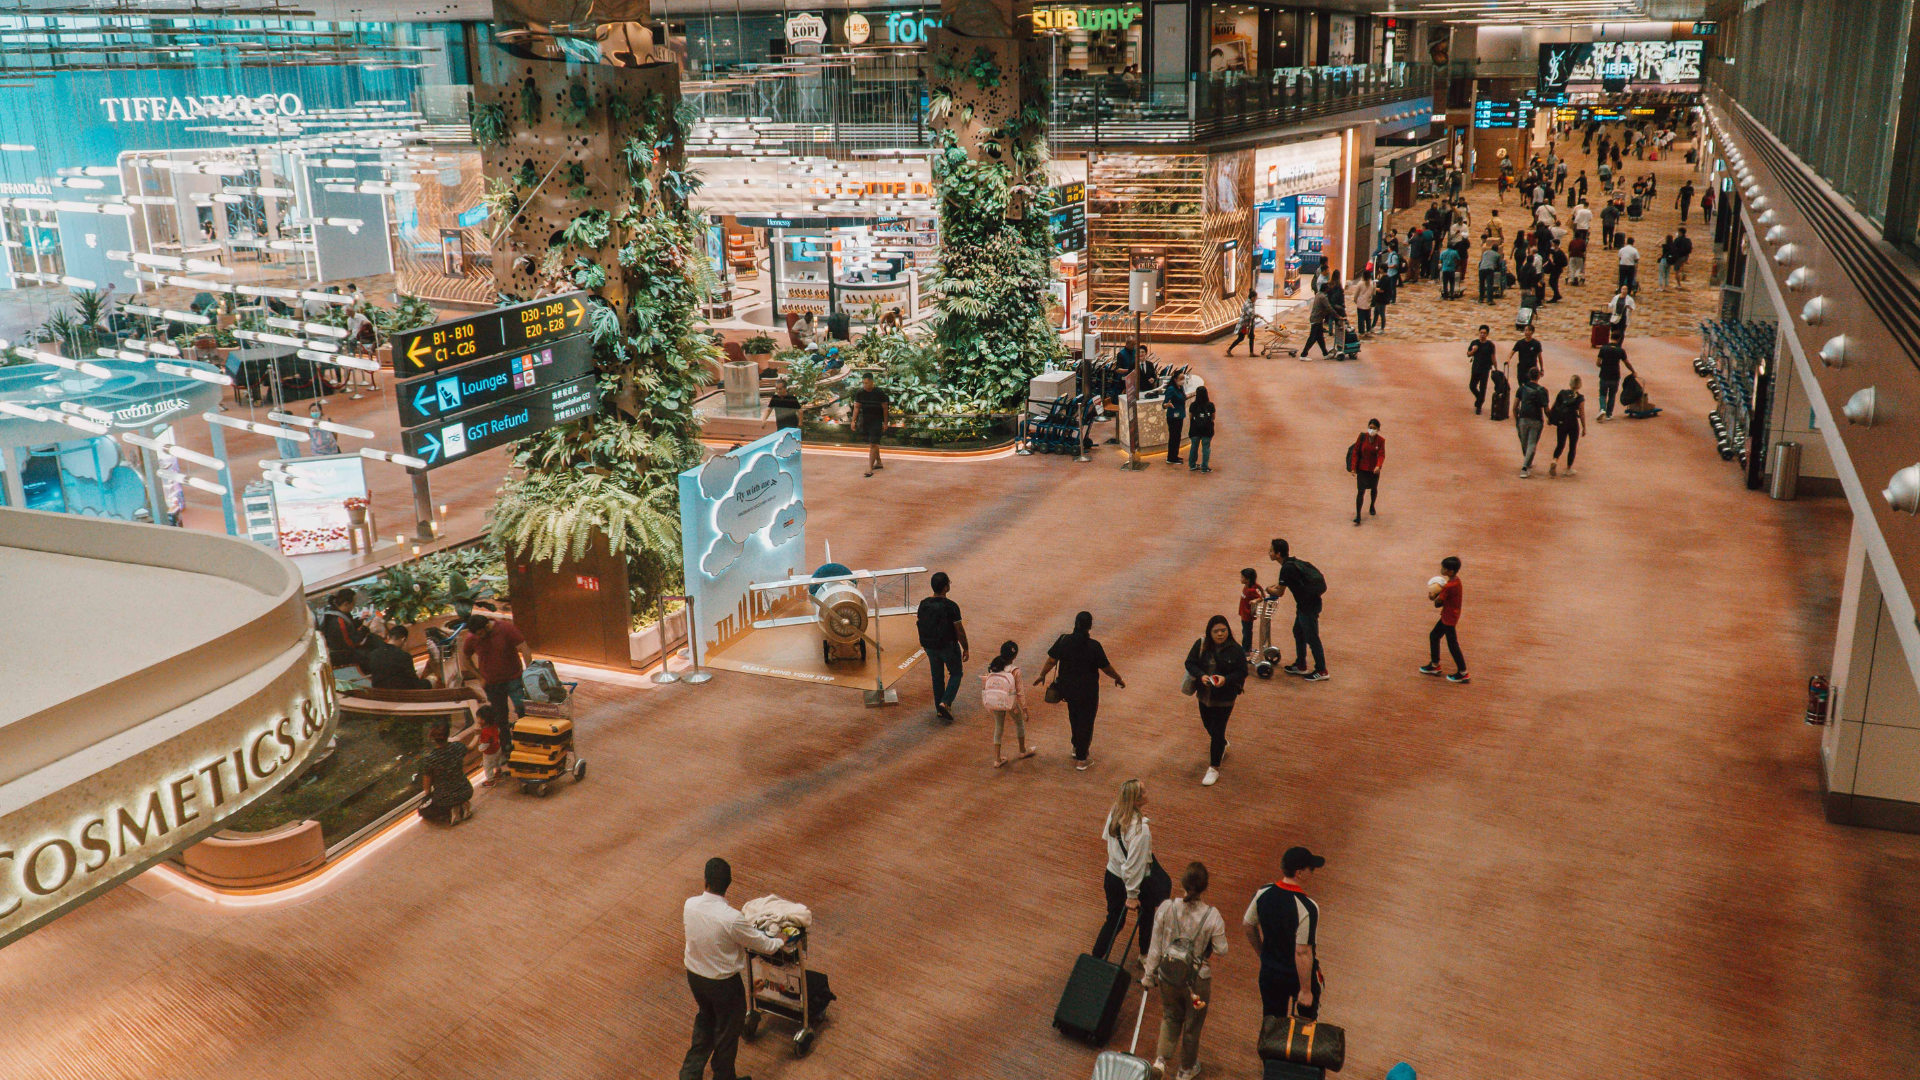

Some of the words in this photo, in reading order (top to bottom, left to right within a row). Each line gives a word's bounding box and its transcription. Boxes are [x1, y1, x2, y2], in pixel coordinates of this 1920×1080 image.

[886, 12, 943, 43] foo
[1033, 7, 1142, 31] SUBWAY
[792, 26, 820, 38] KOPI
[767, 218, 792, 228] Hennessy
[521, 308, 540, 323] D30
[546, 302, 564, 317] D49
[433, 331, 447, 345] B1
[454, 324, 474, 341] B10
[526, 323, 542, 339] E20
[549, 317, 565, 333] E28
[435, 347, 449, 362] C1
[456, 340, 477, 357] C26
[462, 372, 508, 396] Lounges
[581, 391, 591, 401] GST
[467, 422, 489, 441] GST
[491, 408, 529, 434] Refund
[741, 664, 769, 674] PLEASE
[770, 668, 792, 676] MIND
[793, 672, 815, 680] YOUR
[300, 698, 325, 741] &
